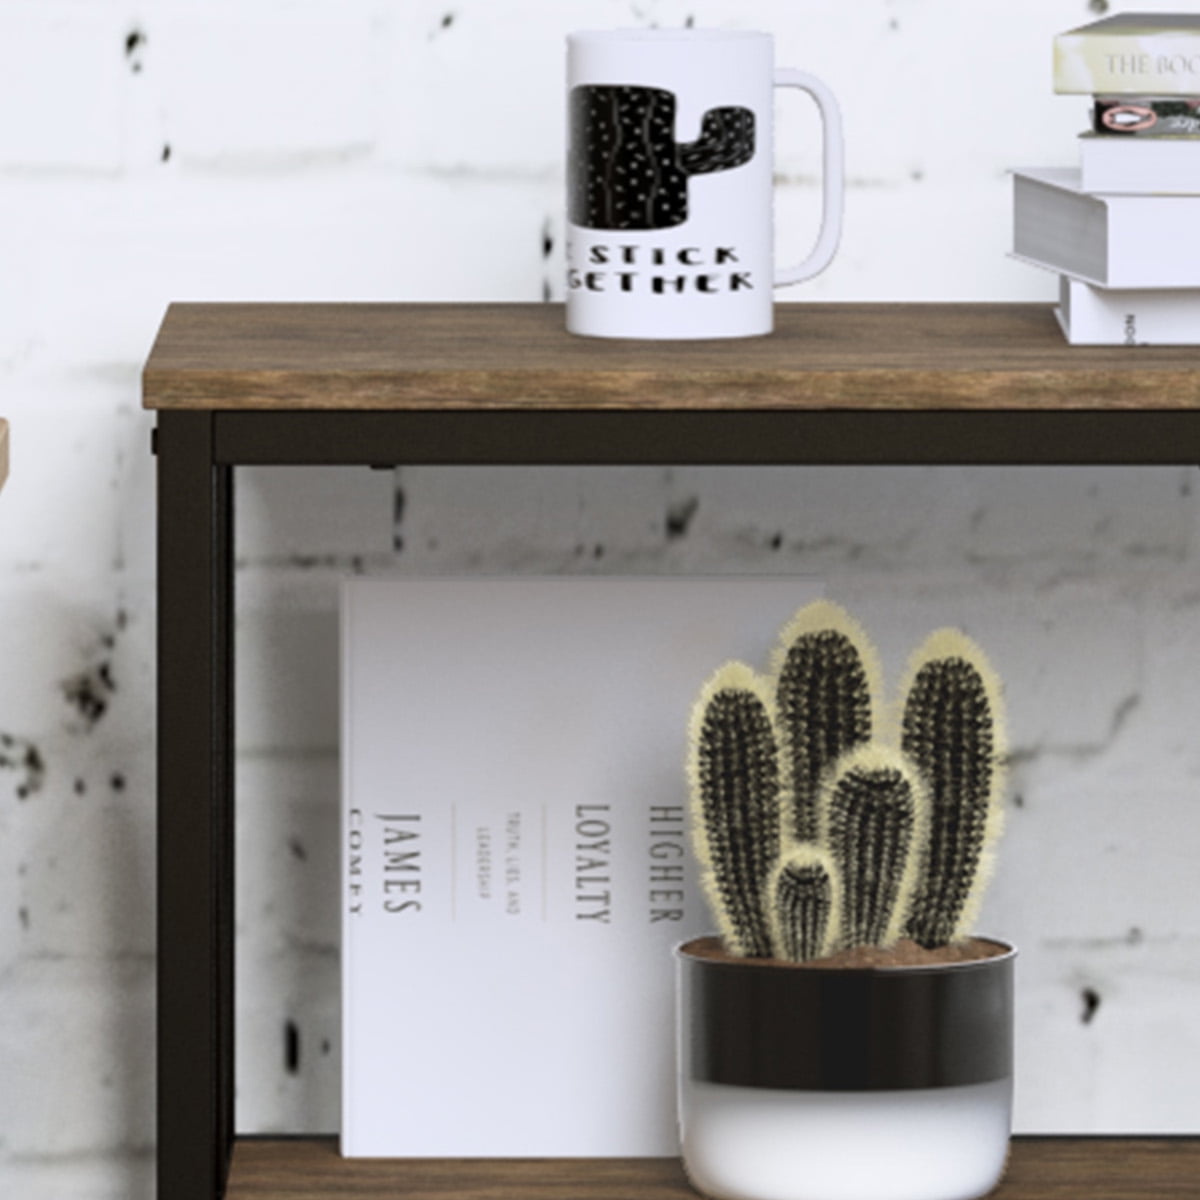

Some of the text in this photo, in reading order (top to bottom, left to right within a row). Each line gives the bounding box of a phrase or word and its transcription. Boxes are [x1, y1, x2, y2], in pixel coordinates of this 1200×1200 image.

[1105, 54, 1150, 75] THE
[589, 245, 738, 265] STICK
[374, 814, 421, 913] JAMES
[575, 804, 610, 924] LOYALTY
[648, 806, 684, 923] HIGHER
